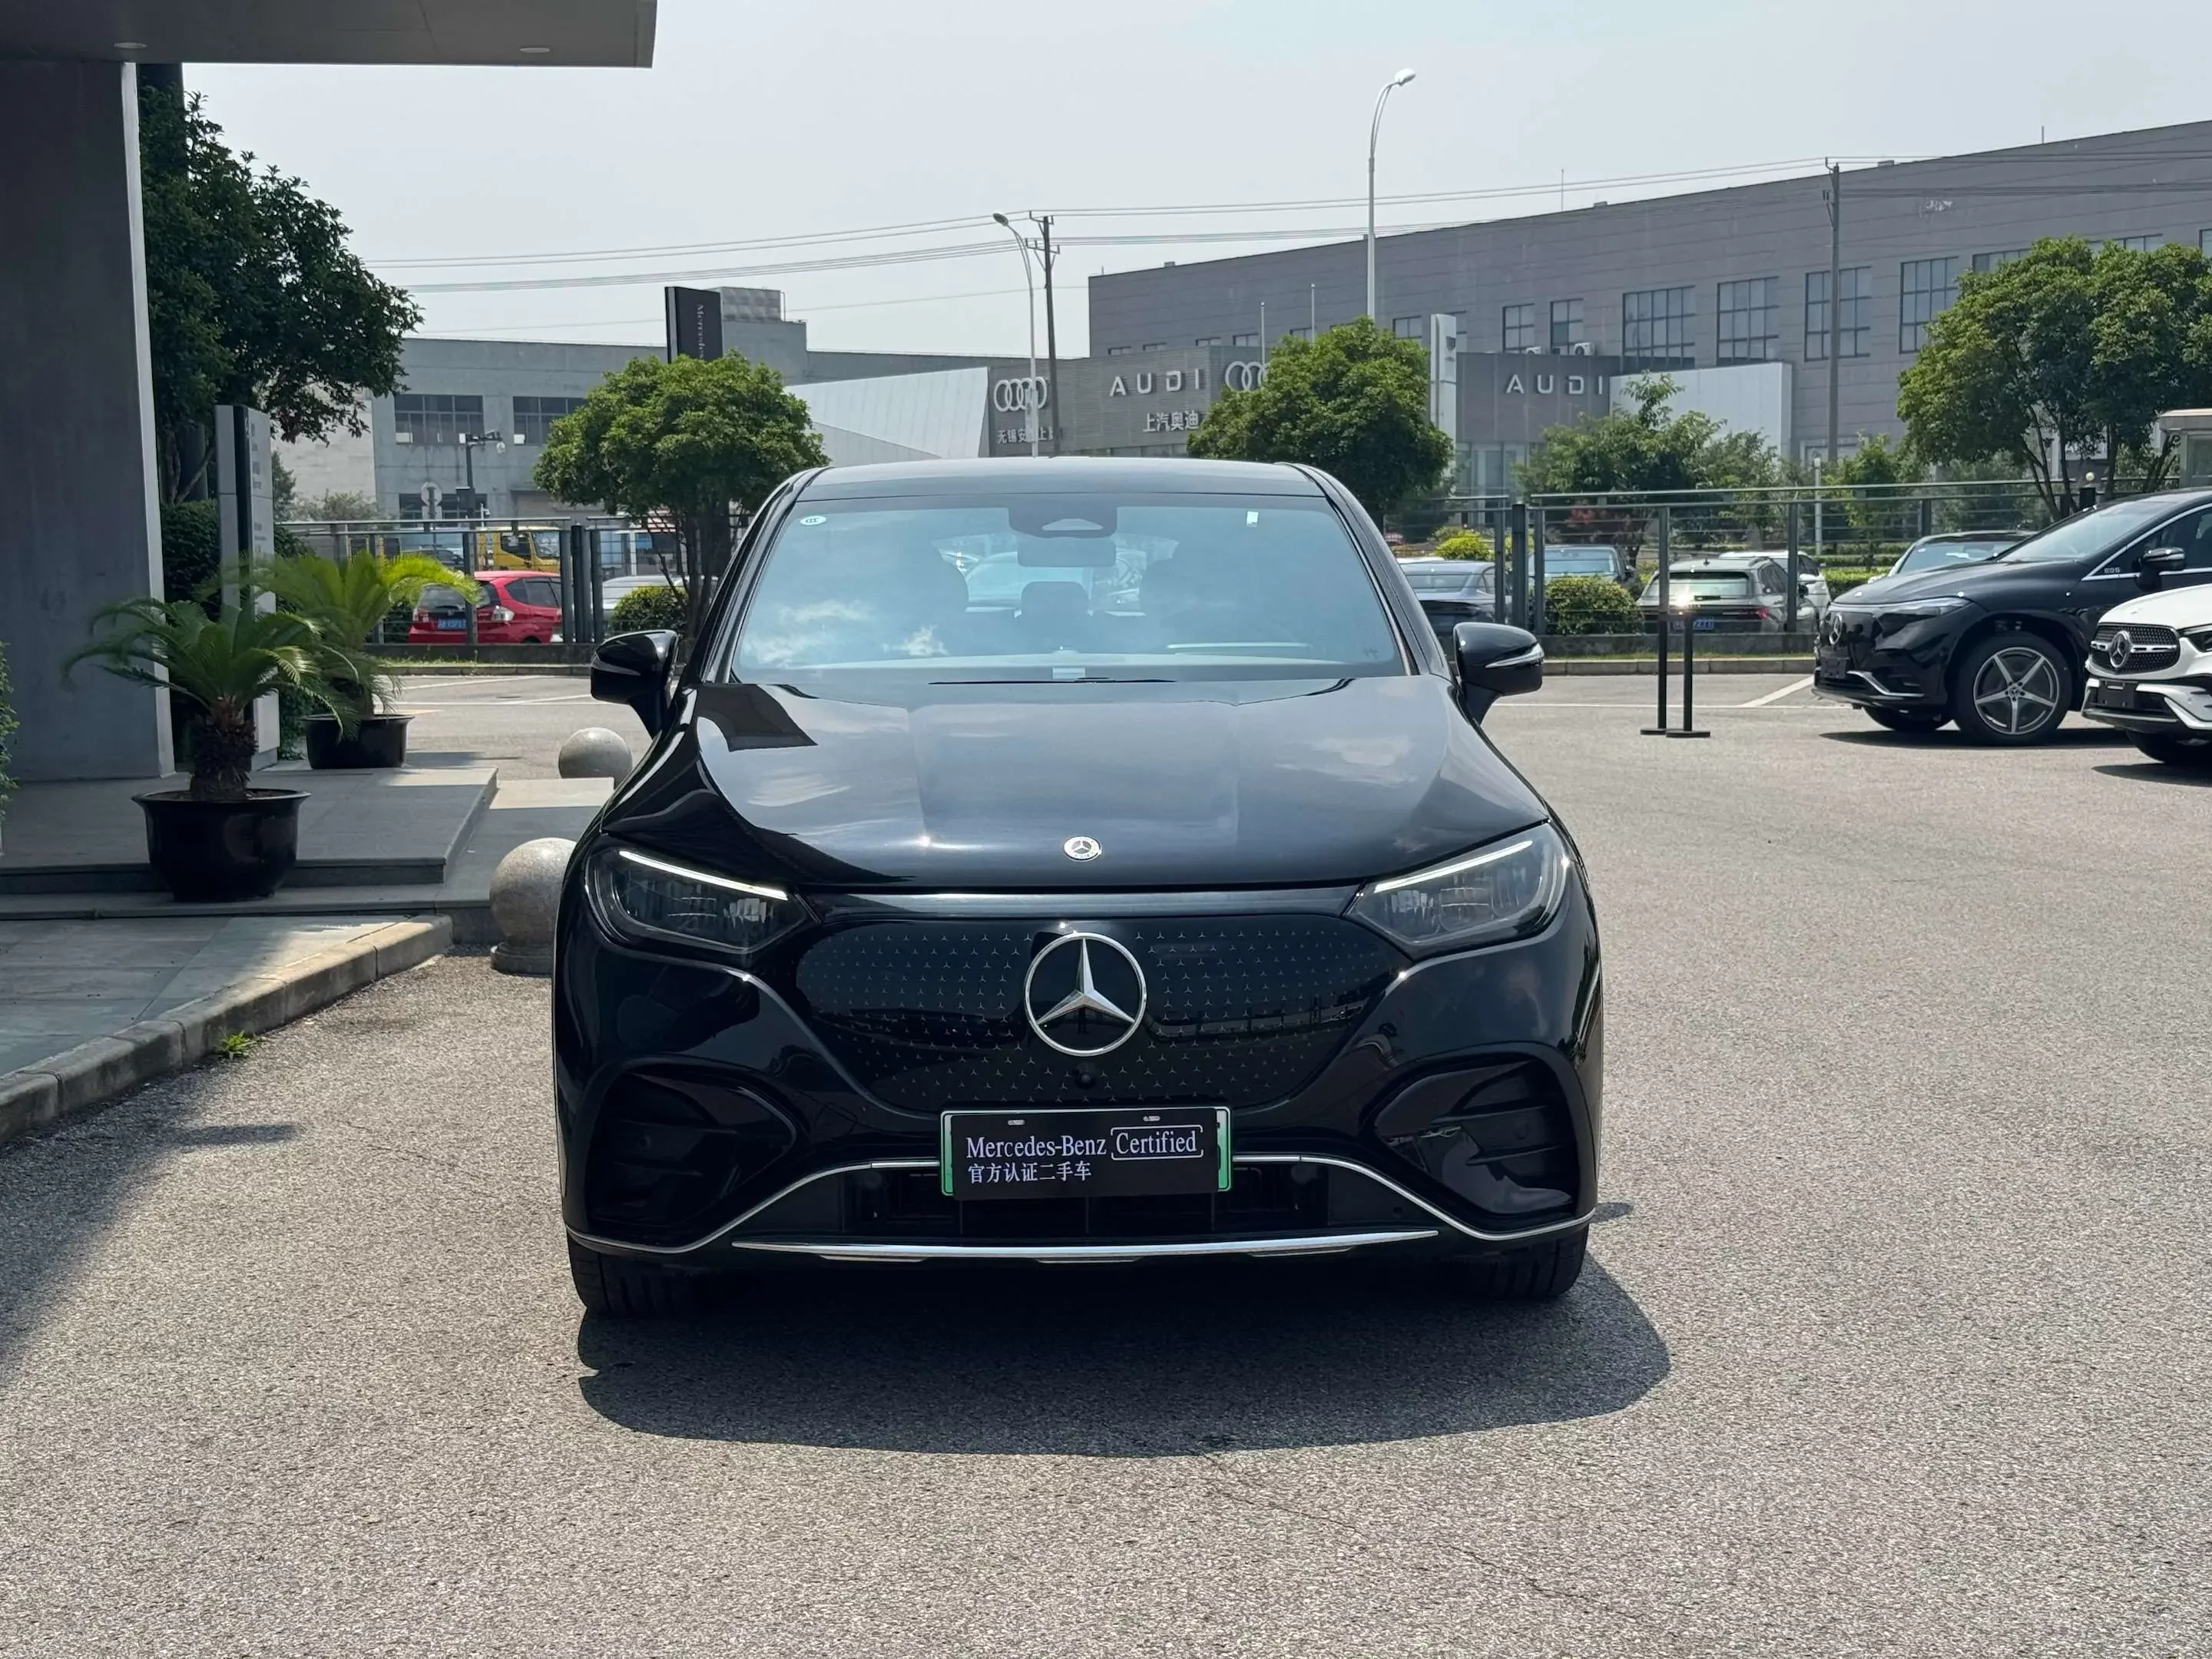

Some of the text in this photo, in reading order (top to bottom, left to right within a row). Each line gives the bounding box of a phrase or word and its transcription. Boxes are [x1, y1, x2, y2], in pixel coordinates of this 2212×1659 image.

[1109, 368, 1200, 396] AUDI
[1506, 374, 1603, 395] AUDI
[1143, 410, 1199, 432] 上汽奥迪
[965, 1131, 1197, 1158] Mercedes-Benz Certified
[968, 1160, 1092, 1184] 官方认证二手车
